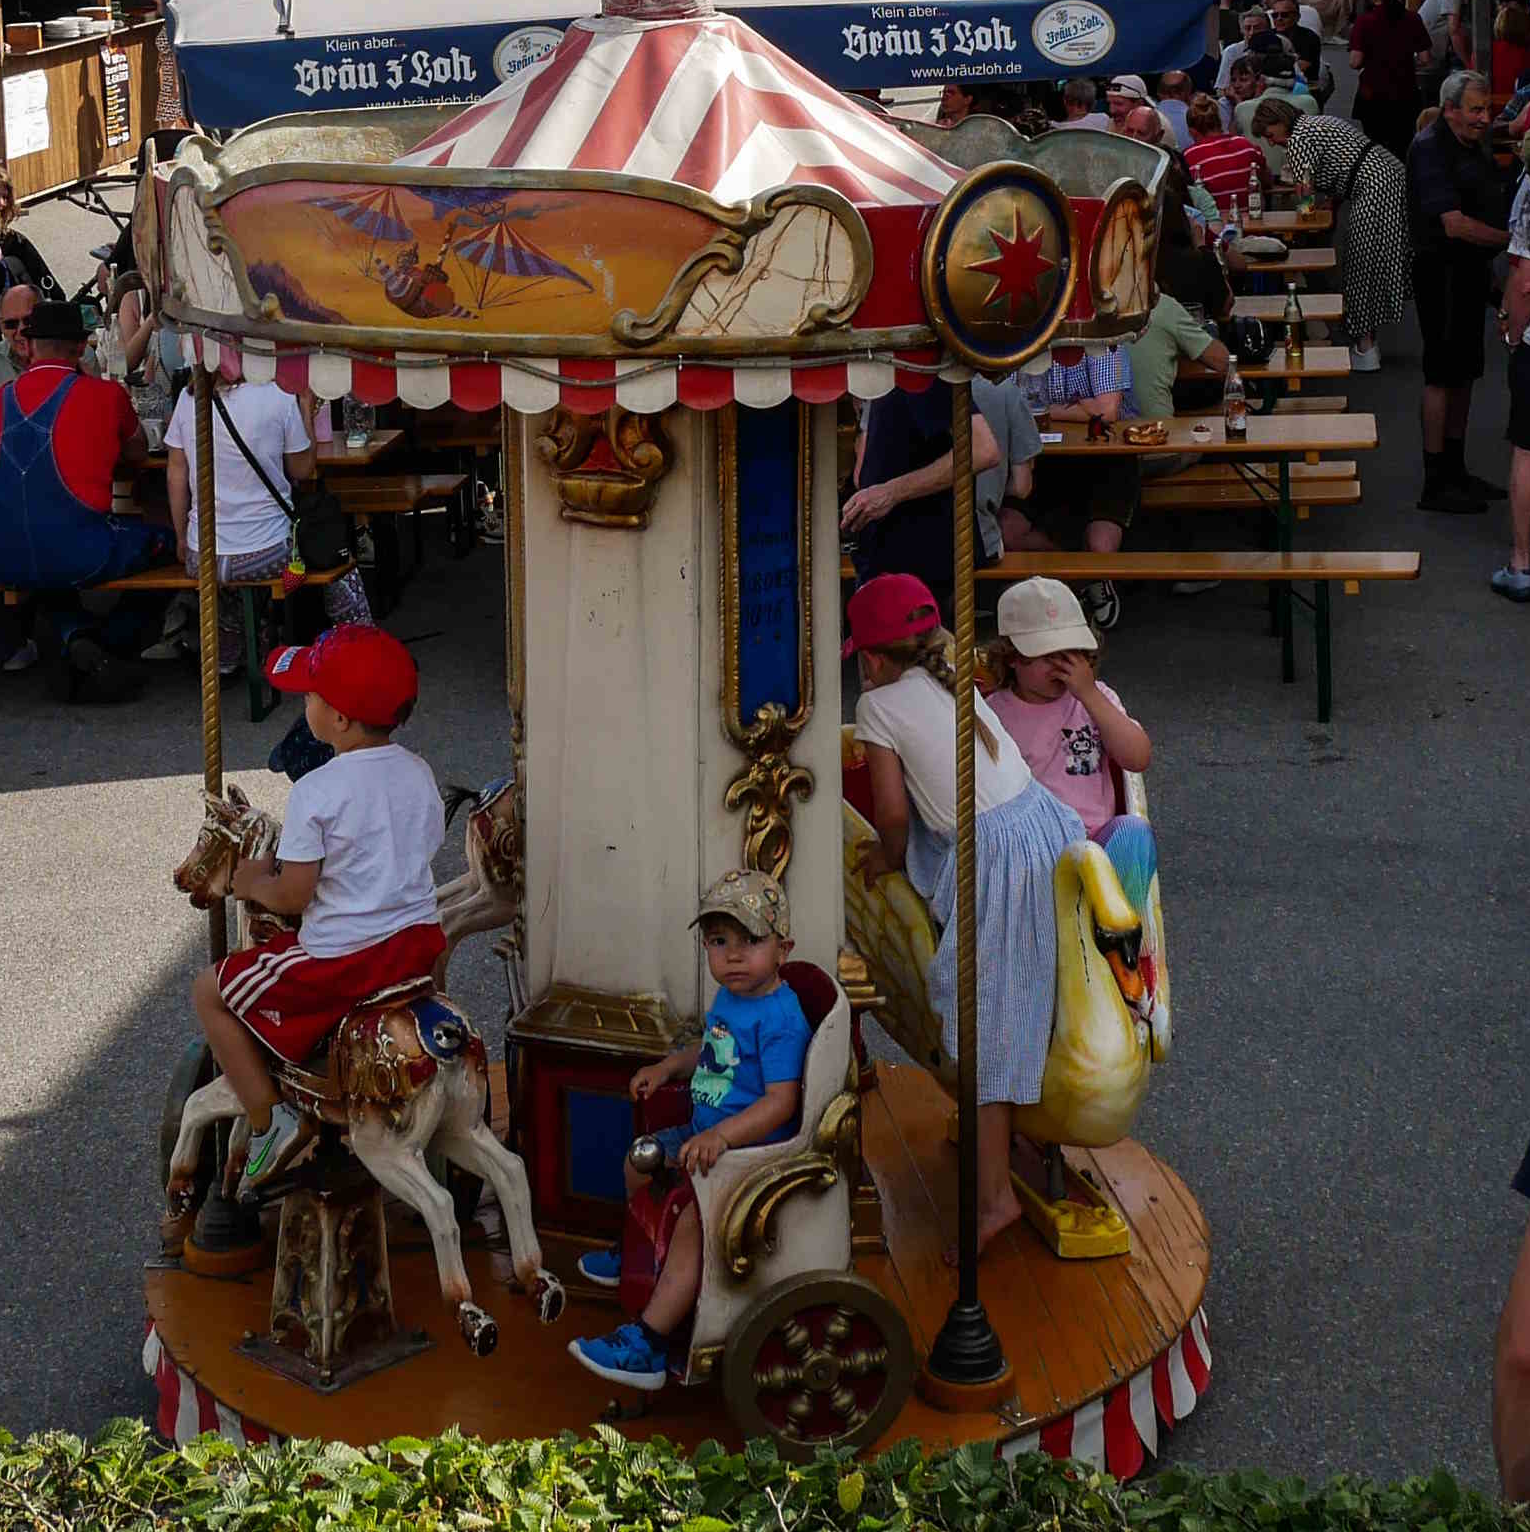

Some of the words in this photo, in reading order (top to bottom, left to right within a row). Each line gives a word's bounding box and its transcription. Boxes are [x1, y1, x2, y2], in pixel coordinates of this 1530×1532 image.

[871, 5, 905, 19] Klein
[326, 38, 360, 53] Klein
[842, 23, 923, 61] Bräu
[294, 58, 378, 97] Bräu
[911, 63, 1022, 79] www.bräuzloh.de
